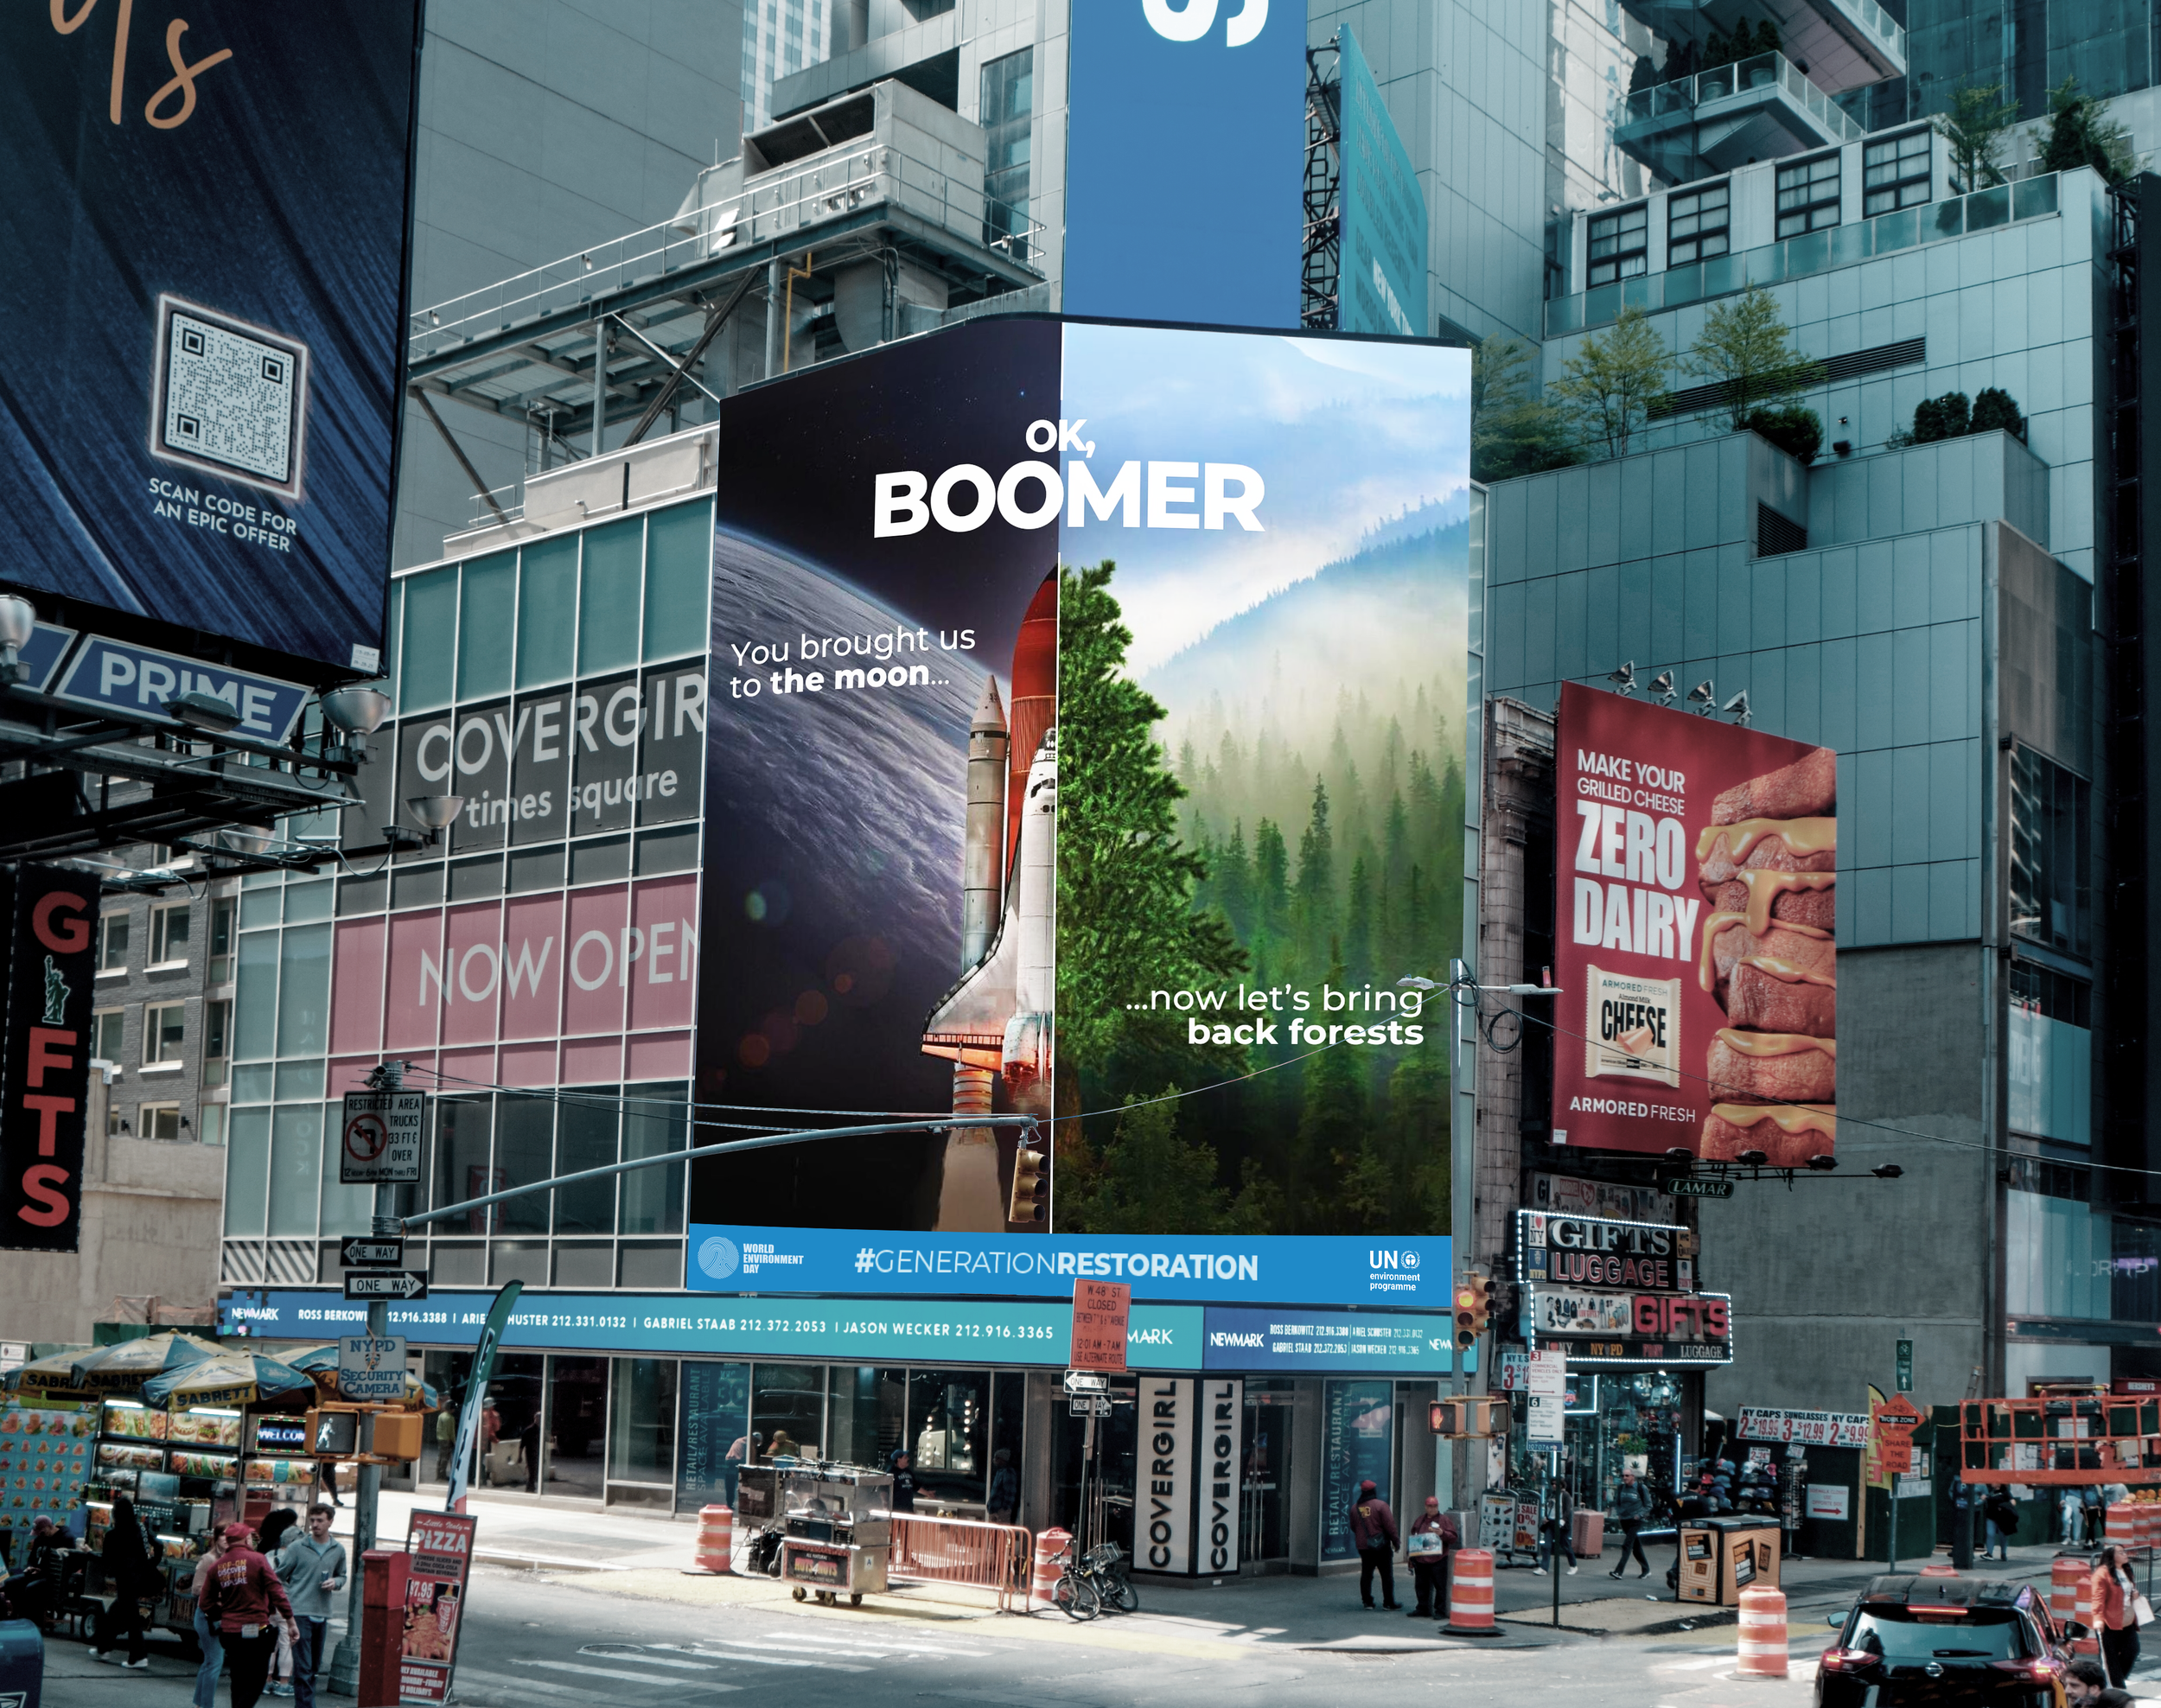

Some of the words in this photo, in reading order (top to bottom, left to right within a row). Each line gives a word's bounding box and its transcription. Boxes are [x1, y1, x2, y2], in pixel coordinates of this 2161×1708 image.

[1026, 419, 1095, 459] OK,
[149, 478, 199, 506] SCAN
[205, 494, 256, 523] CODE
[262, 511, 296, 535] FOR
[874, 460, 1265, 538] BOOMER
[153, 500, 182, 520] AN
[188, 508, 227, 533] EPIC
[233, 523, 290, 552] OFFER
[730, 642, 788, 666] You
[800, 626, 928, 667] brought
[940, 626, 975, 651] us
[100, 650, 277, 733] PRIME
[730, 674, 761, 698] to
[770, 667, 824, 693] the
[1578, 749, 1632, 782] MAKE
[1635, 762, 1685, 793] YOUR
[466, 790, 552, 828] times
[568, 769, 679, 819] square
[1578, 777, 1631, 804] GRILLED
[1634, 790, 1685, 816] CHEESE
[1575, 800, 1686, 890] ZERO
[1573, 876, 1699, 962] DAIRY
[418, 936, 554, 1007] NOW
[1603, 978, 1641, 992] ARMORED
[1643, 985, 1667, 997] FRESH
[1323, 984, 1423, 1017] bring
[1618, 993, 1639, 1003] Almond
[1189, 1017, 1278, 1044] back
[1289, 1017, 1424, 1044] forests
[1602, 999, 1666, 1048] CHEESE
[349, 1099, 392, 1110] RESTRICTED
[398, 1099, 419, 1110] AREA
[1570, 1096, 1648, 1117] ARMORED
[1650, 1105, 1695, 1122] FRESH
[390, 1115, 418, 1126] TRUCKS
[402, 1132, 410, 1144] FT
[392, 1150, 412, 1161] OVER
[379, 1167, 392, 1176] MON
[406, 1167, 417, 1176] FRI
[1673, 1181, 1727, 1195] LAMAR
[1530, 1229, 1544, 1243] NY
[1550, 1219, 1670, 1256] GIFTS
[350, 1246, 367, 1259] ONE
[375, 1246, 394, 1259] WAY
[743, 1243, 775, 1253] WORLD
[743, 1253, 804, 1265] ENVIRONMENT
[743, 1263, 760, 1274] DAY
[855, 1248, 1259, 1281] #GENERATIONRESTORATION
[1369, 1250, 1398, 1269] UN
[1369, 1272, 1421, 1283] environment
[1555, 1252, 1669, 1287] LUGGAGE
[356, 1279, 380, 1291] ONE
[392, 1279, 416, 1291] WAY
[1369, 1283, 1417, 1292] programme
[1087, 1299, 1116, 1311] CLOSED
[232, 1308, 279, 1321] NEWMARK
[298, 1310, 322, 1320] ROSS
[325, 1310, 367, 1322] BERKOWI
[387, 1310, 447, 1323] 12.916.3388
[462, 1312, 487, 1325] ARIE
[507, 1314, 548, 1326] HUSTER
[551, 1315, 627, 1329] 212.331.0132
[643, 1316, 693, 1329] GABRIEL
[697, 1318, 736, 1330] STAAB
[740, 1318, 826, 1333] 212.372.2053
[843, 1322, 888, 1335] JASON
[893, 1322, 950, 1336] WECKER
[955, 1324, 1054, 1339] 212.916.3365
[1635, 1296, 1728, 1336] GIFTS
[1093, 1340, 1101, 1349] AM
[1107, 1341, 1111, 1349] 7
[1112, 1342, 1121, 1350] AM
[1210, 1332, 1265, 1347] NEWMARK
[1270, 1324, 1283, 1335] ROSS
[1284, 1325, 1314, 1336] BERKOWITZ
[1352, 1327, 1366, 1337] ARIEL
[1367, 1327, 1392, 1338] SCHUSTER
[350, 1340, 396, 1353] NYPD
[1272, 1342, 1293, 1354] GABRIEL
[1295, 1342, 1312, 1354] STAAB
[1351, 1343, 1366, 1354] JASON
[1367, 1344, 1387, 1354] WECKER
[1680, 1346, 1723, 1359] LUGGAGE
[1084, 1352, 1107, 1363] ALTERNATE
[1109, 1354, 1123, 1364] ROUTE
[1533, 1352, 1539, 1361] 3
[1071, 1378, 1083, 1386] ONE
[1091, 1379, 1105, 1387] WAY
[176, 1386, 252, 1406] SABRETT
[1074, 1400, 1087, 1409] ONE
[1532, 1399, 1538, 1407] 6
[698, 1369, 711, 1444] AVAILABLE
[1742, 1408, 1755, 1417] NY
[1756, 1409, 1782, 1419] CAPS
[1783, 1411, 1828, 1422] SUNGLASSES
[1832, 1414, 1844, 1423] NY
[1738, 1416, 1749, 1438] 2
[1880, 1415, 1899, 1424] WORK
[685, 1368, 701, 1491] RETAIL/RESTAURANT
[1342, 1389, 1352, 1477] AVAILABLE
[1782, 1418, 1793, 1441] 3
[1829, 1423, 1839, 1445] 2
[1885, 1439, 1910, 1448] SHARE
[698, 1447, 708, 1492] SPACE
[1329, 1386, 1342, 1536] RETAIL/RESTAURANT
[1149, 1380, 1176, 1568] COVERGIRL
[1211, 1383, 1233, 1570] COVERGIRL
[1341, 1482, 1350, 1536] SPACE
[1521, 1506, 1537, 1515] SALE
[217, 1565, 247, 1577] DISCOVER
[410, 1580, 434, 1598] $7.95
[410, 1667, 439, 1679] AVAILABLE
[405, 1686, 432, 1697] HOLIDAYS
